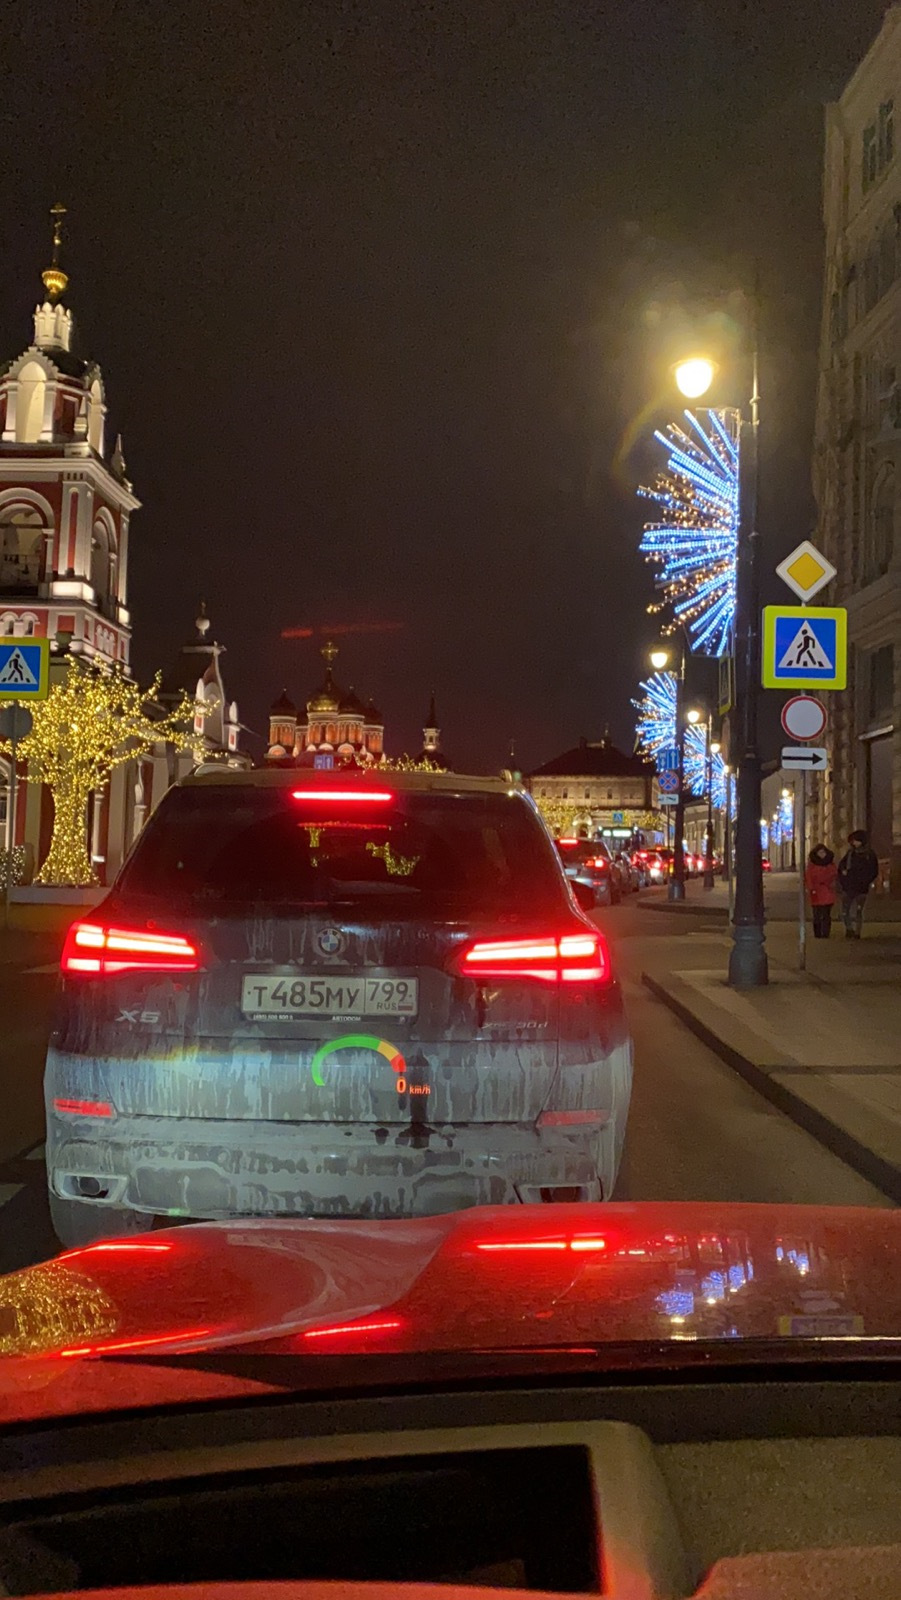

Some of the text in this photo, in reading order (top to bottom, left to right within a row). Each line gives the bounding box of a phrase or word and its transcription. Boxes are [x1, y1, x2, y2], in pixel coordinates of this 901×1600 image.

[368, 981, 409, 1002] 799
[377, 1002, 397, 1011] RUS
[115, 1009, 160, 1024] X5
[397, 1076, 431, 1095] 0 km/h
